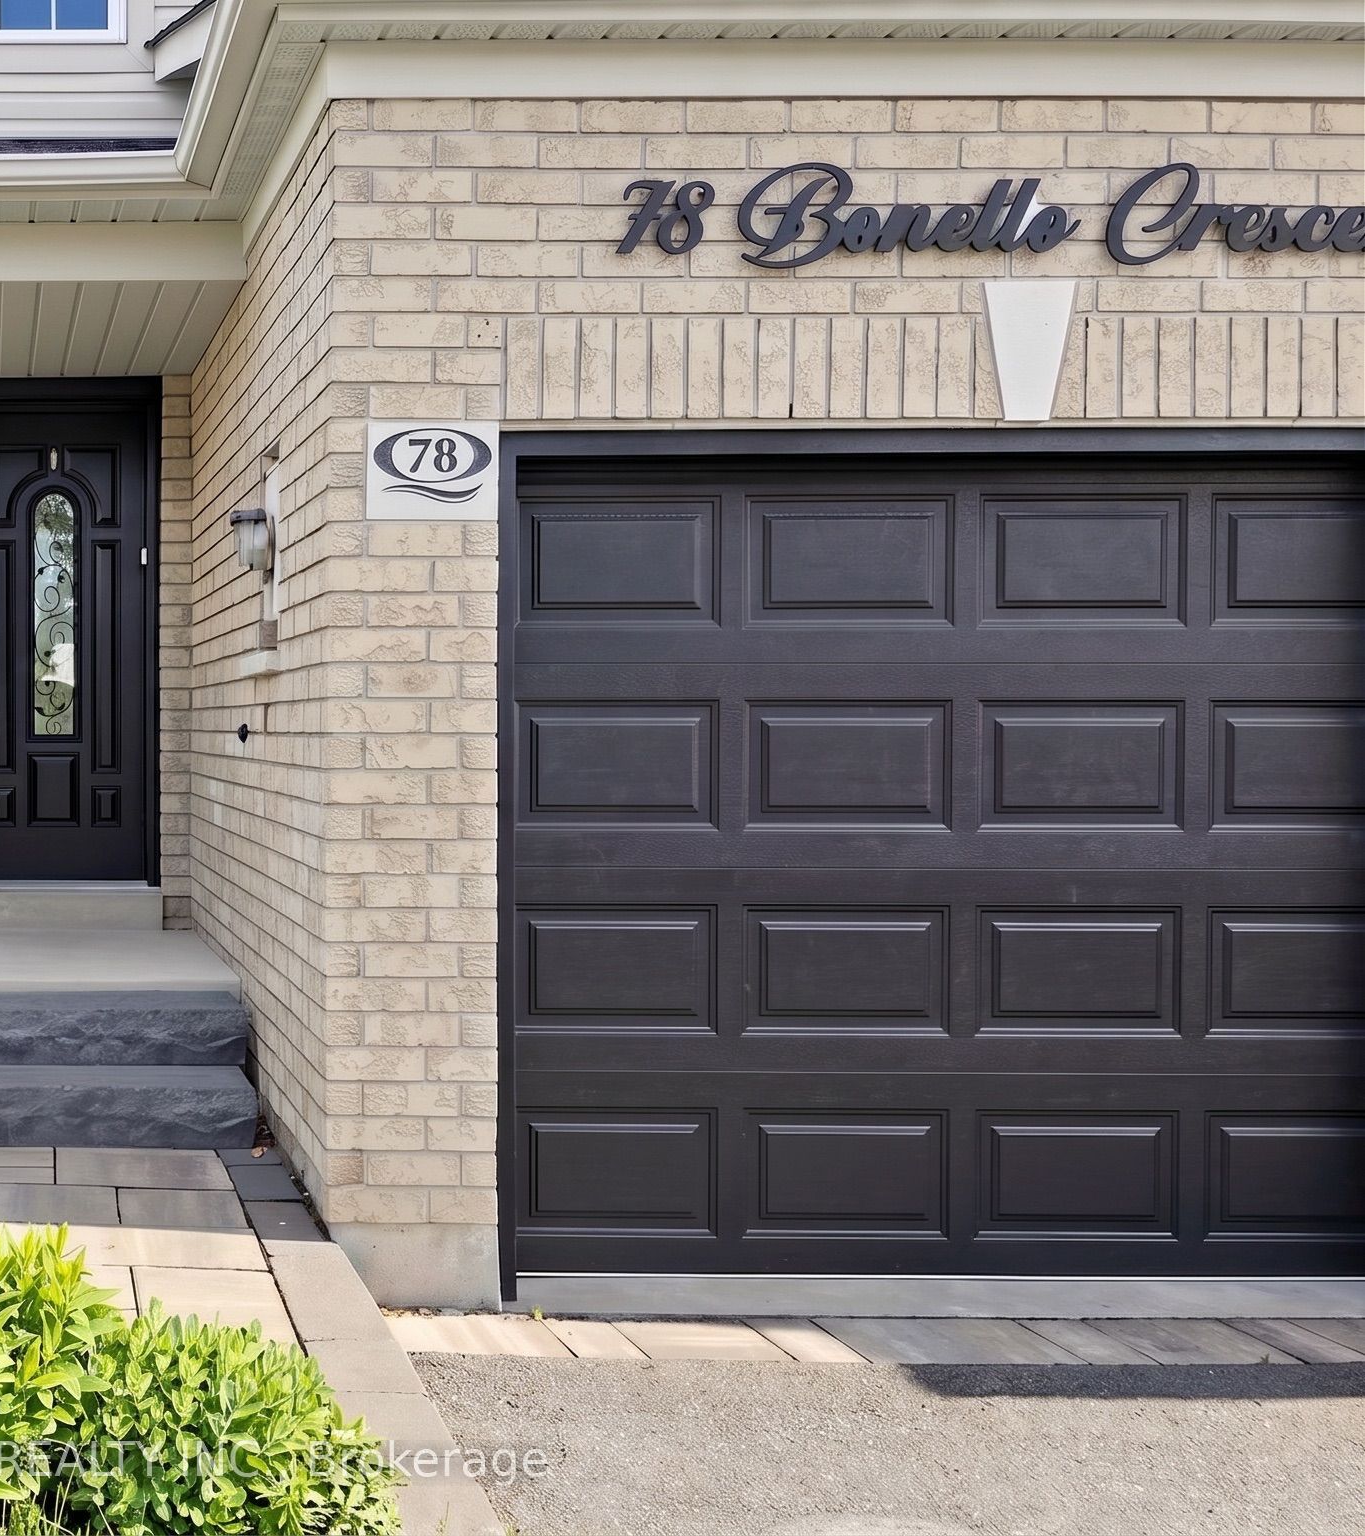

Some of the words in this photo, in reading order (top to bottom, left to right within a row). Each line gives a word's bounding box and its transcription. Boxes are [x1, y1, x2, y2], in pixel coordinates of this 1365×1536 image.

[615, 180, 716, 255] 78
[737, 162, 1082, 269] Bonello
[1105, 162, 1365, 266] Cresce
[408, 437, 458, 474] 78
